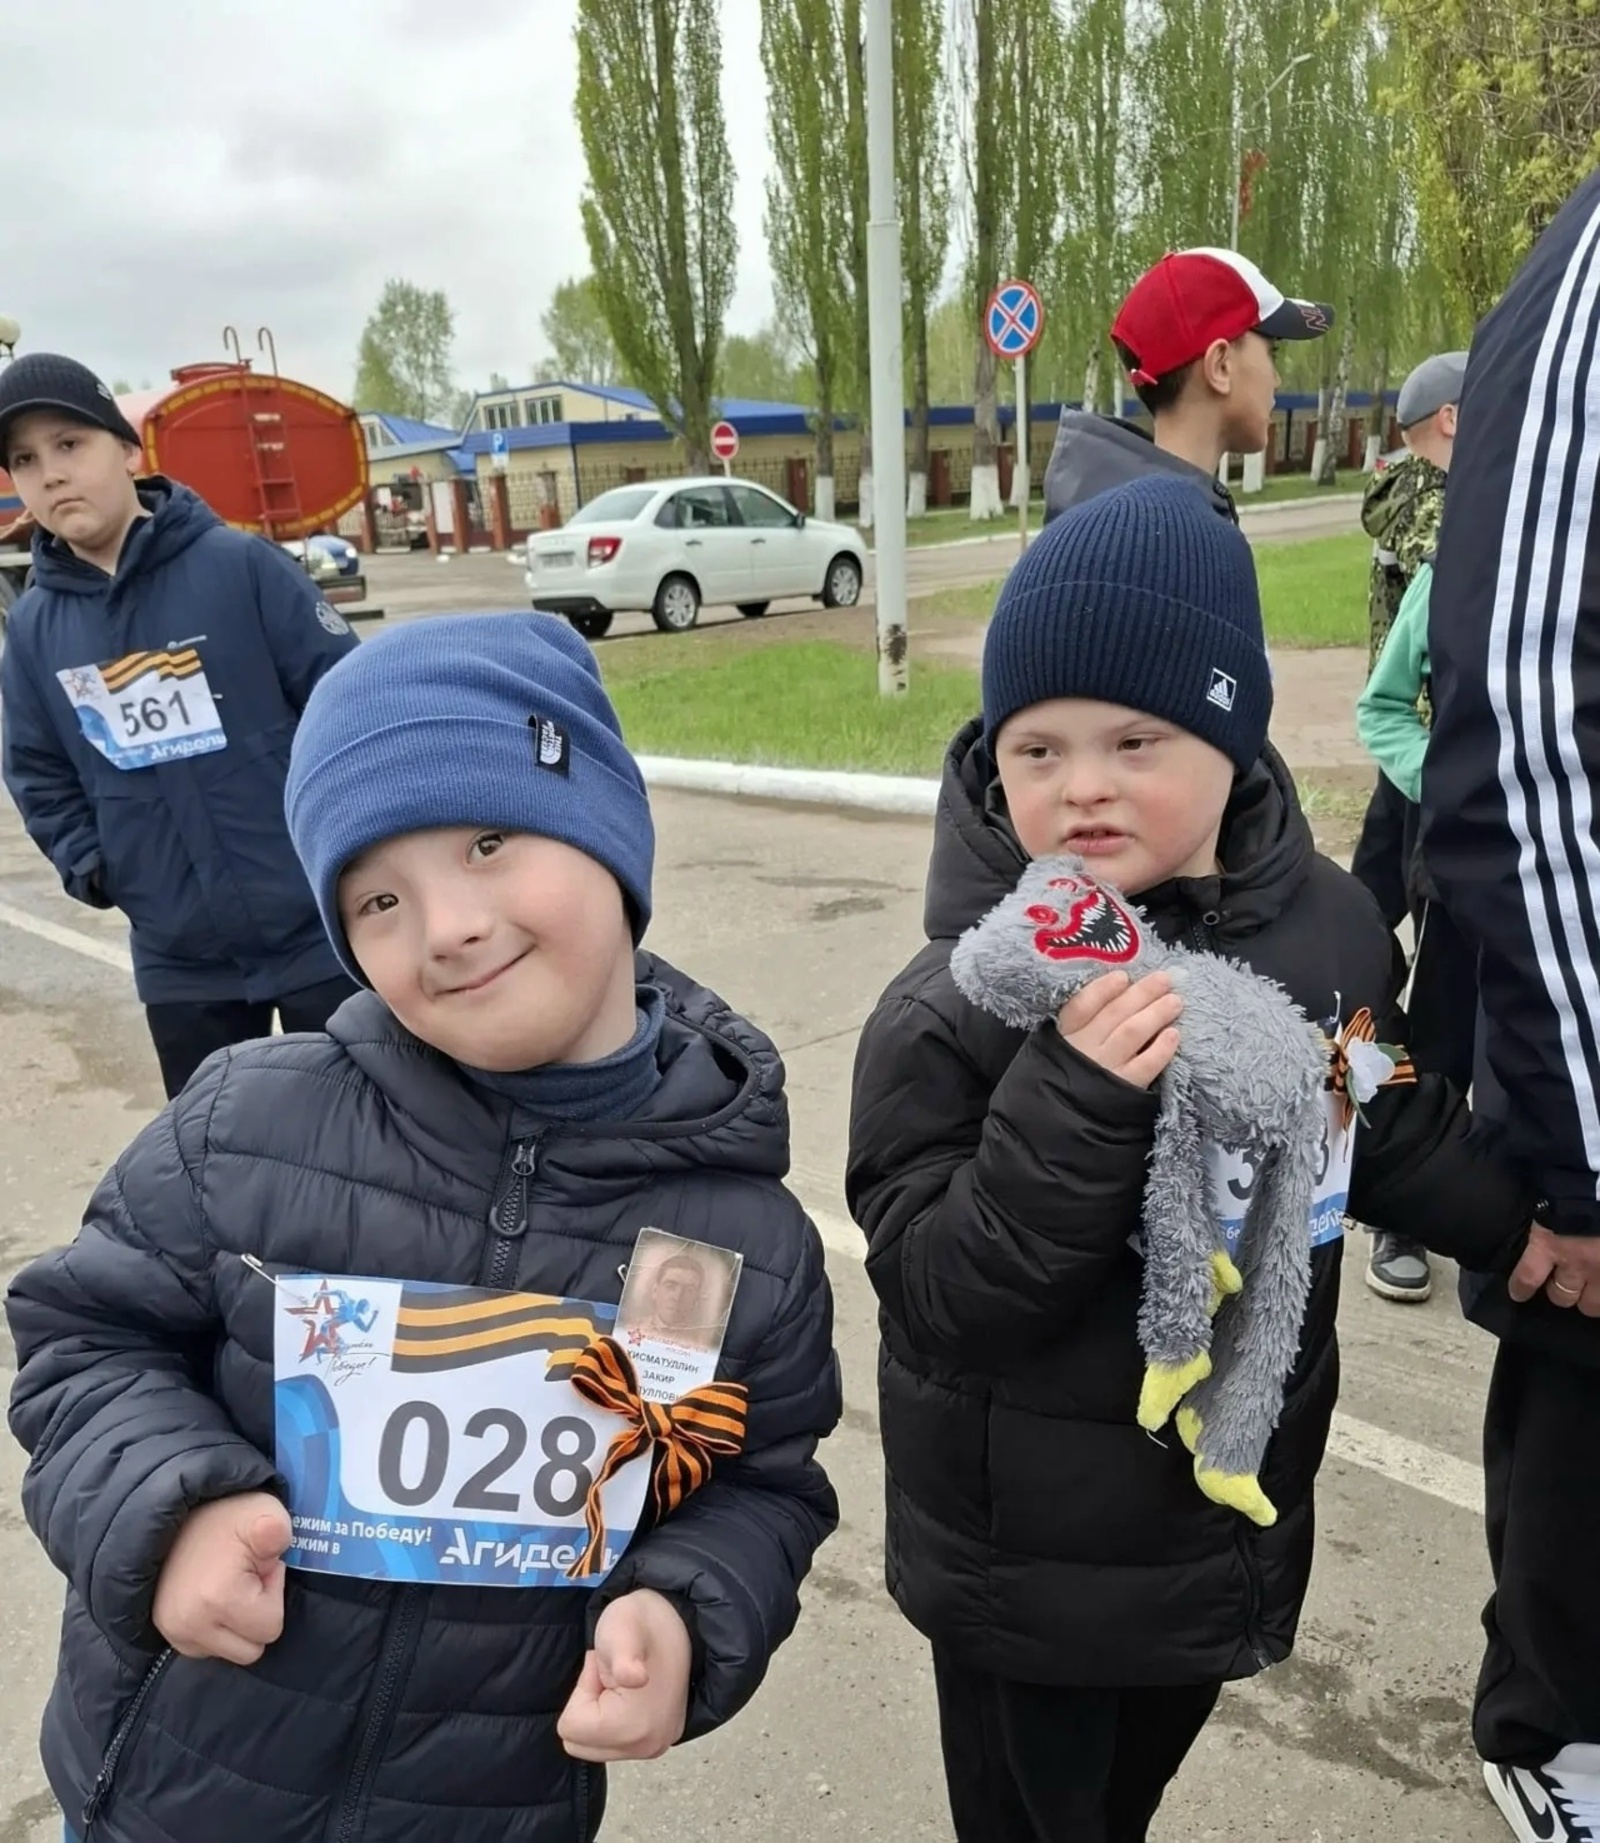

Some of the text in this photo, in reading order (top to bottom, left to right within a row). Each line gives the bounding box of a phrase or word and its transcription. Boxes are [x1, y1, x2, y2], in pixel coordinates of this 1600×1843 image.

[120, 690, 190, 737] 561
[642, 1369, 675, 1384] ЗАКИР
[378, 1400, 597, 1517] 028
[289, 1536, 341, 1555] ежим в
[292, 1515, 432, 1547] ежим за Победу!
